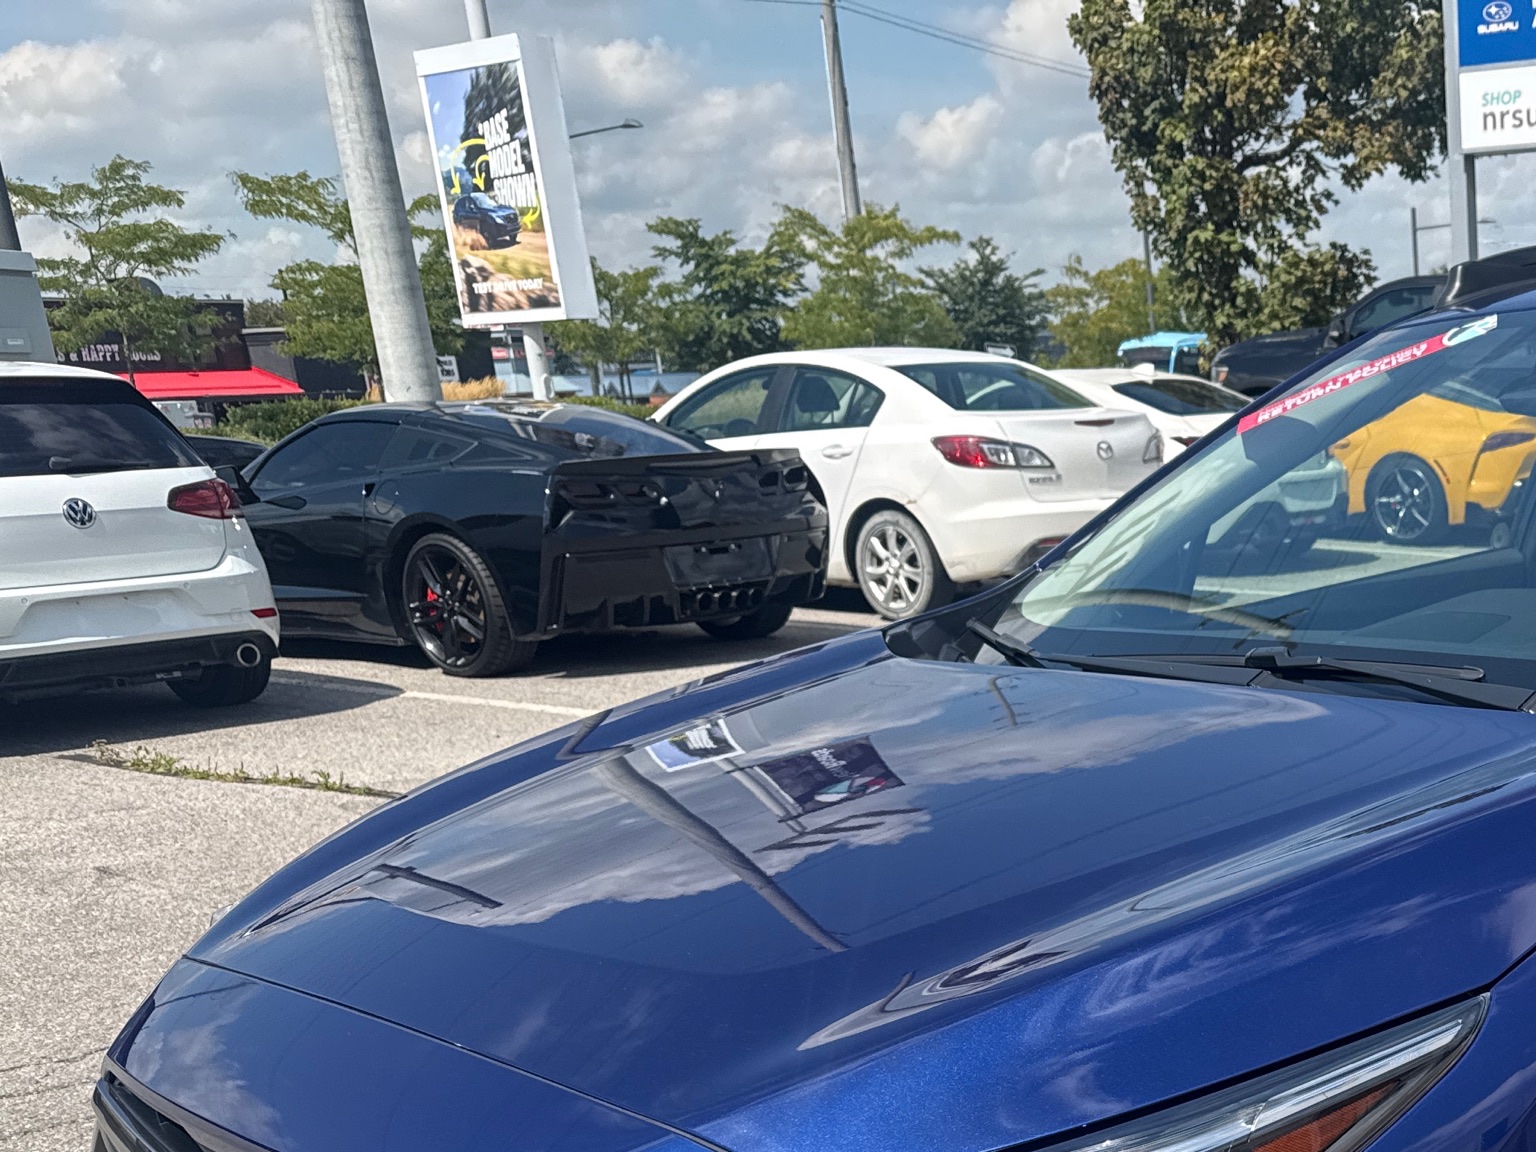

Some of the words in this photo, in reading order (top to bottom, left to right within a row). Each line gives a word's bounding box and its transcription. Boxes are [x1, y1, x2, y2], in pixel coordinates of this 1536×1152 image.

[1482, 90, 1522, 107] SHOP
[488, 139, 526, 179] MODEL
[493, 172, 538, 208] SHOWN
[518, 277, 543, 291] TODAY
[81, 344, 120, 361] HAPPY
